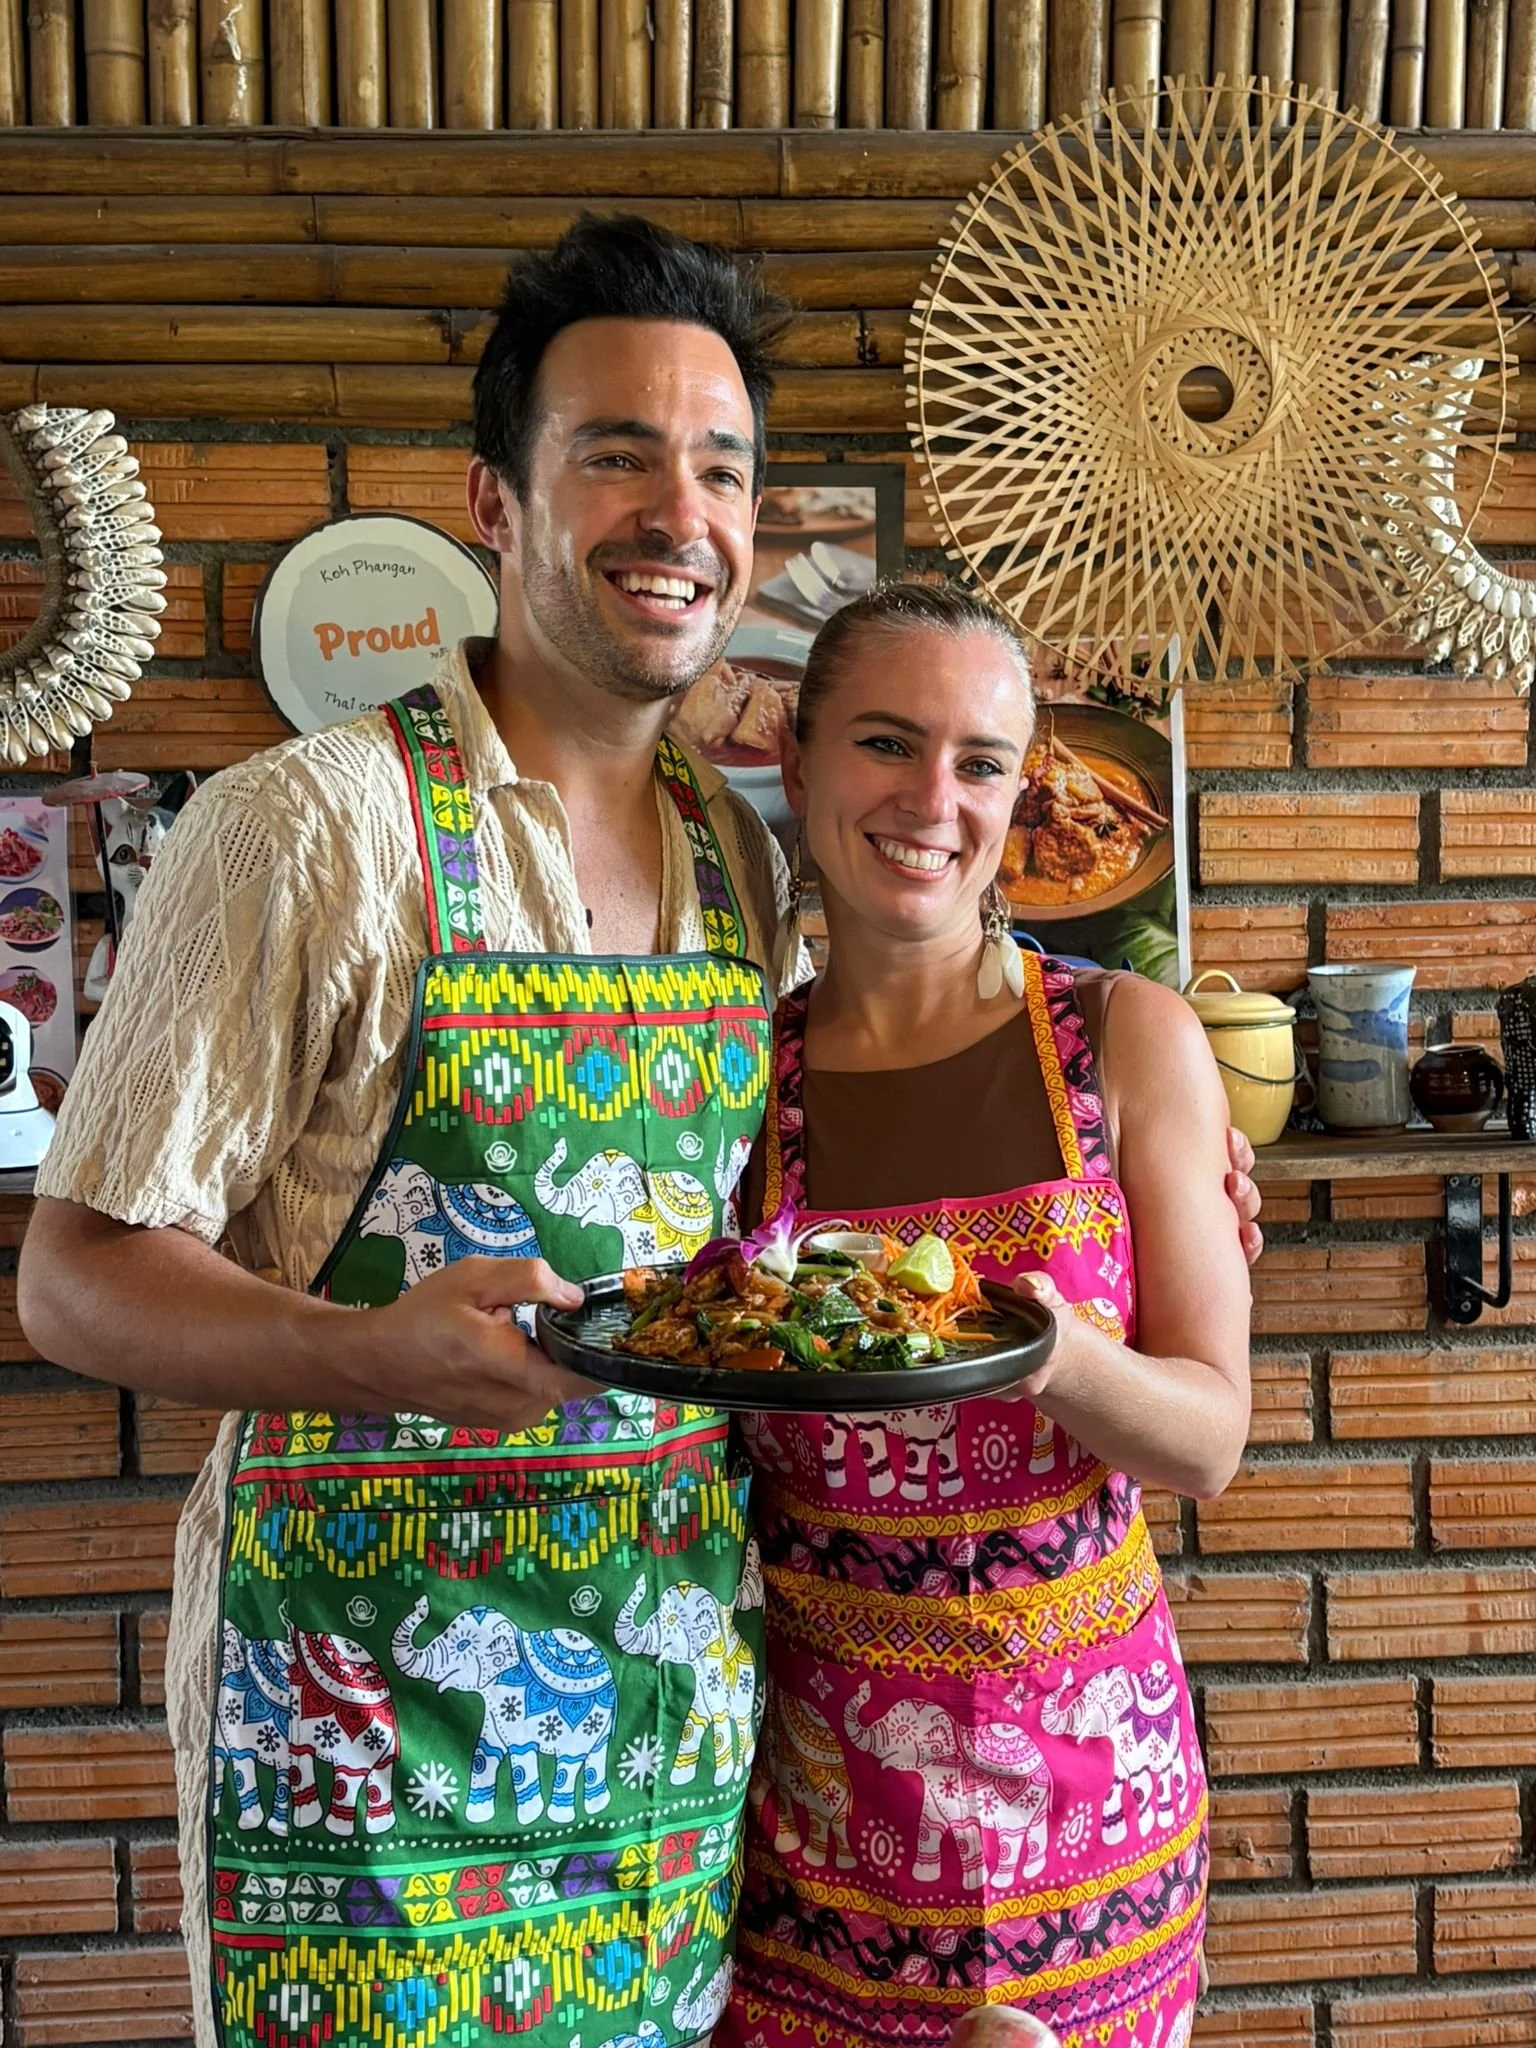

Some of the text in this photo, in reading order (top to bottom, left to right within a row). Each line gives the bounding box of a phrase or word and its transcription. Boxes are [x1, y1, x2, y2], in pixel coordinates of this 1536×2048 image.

[319, 559, 416, 584] Koh Phangan
[313, 607, 440, 662] Proud
[324, 691, 356, 711] Thai
